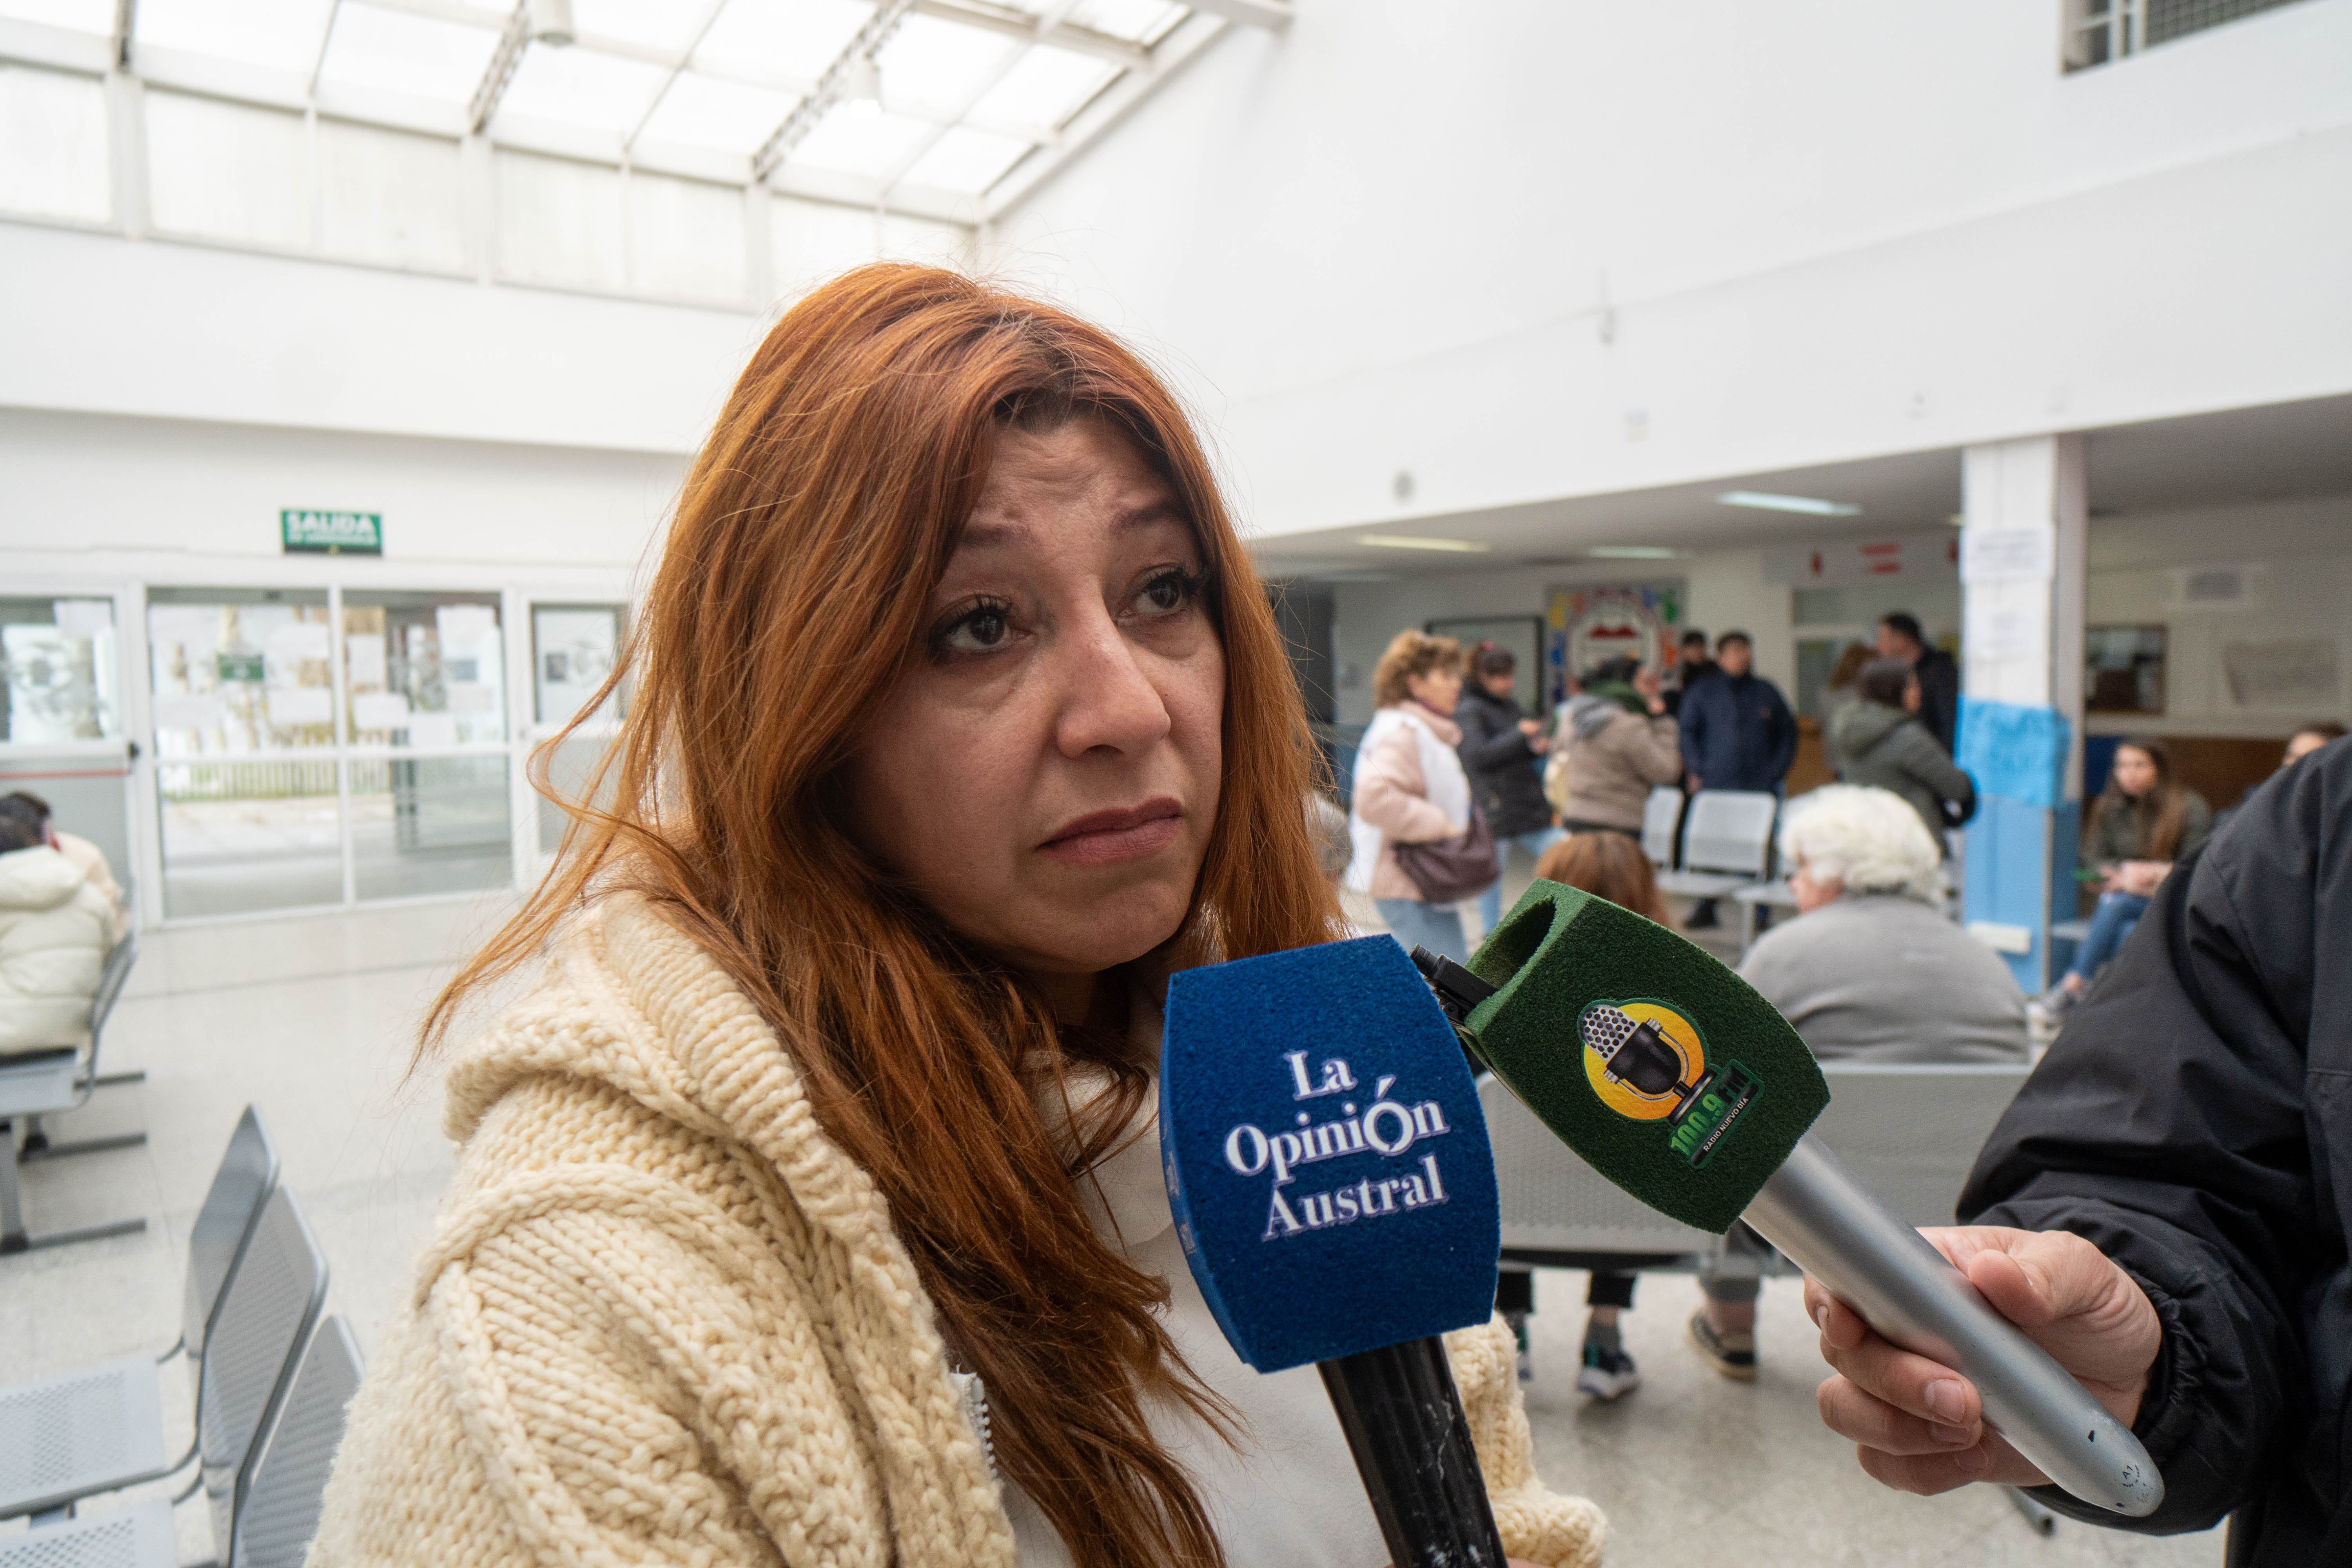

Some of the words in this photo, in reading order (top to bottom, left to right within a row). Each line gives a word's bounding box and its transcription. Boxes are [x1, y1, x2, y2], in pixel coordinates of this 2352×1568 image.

[1285, 1051, 1357, 1100] La
[1715, 1064, 1749, 1104] FM
[1703, 1131, 1721, 1151] RADIO
[1719, 1108, 1739, 1131] NUEVO
[1737, 1098, 1749, 1110] DÍA
[1265, 1156, 1445, 1238] Austral
